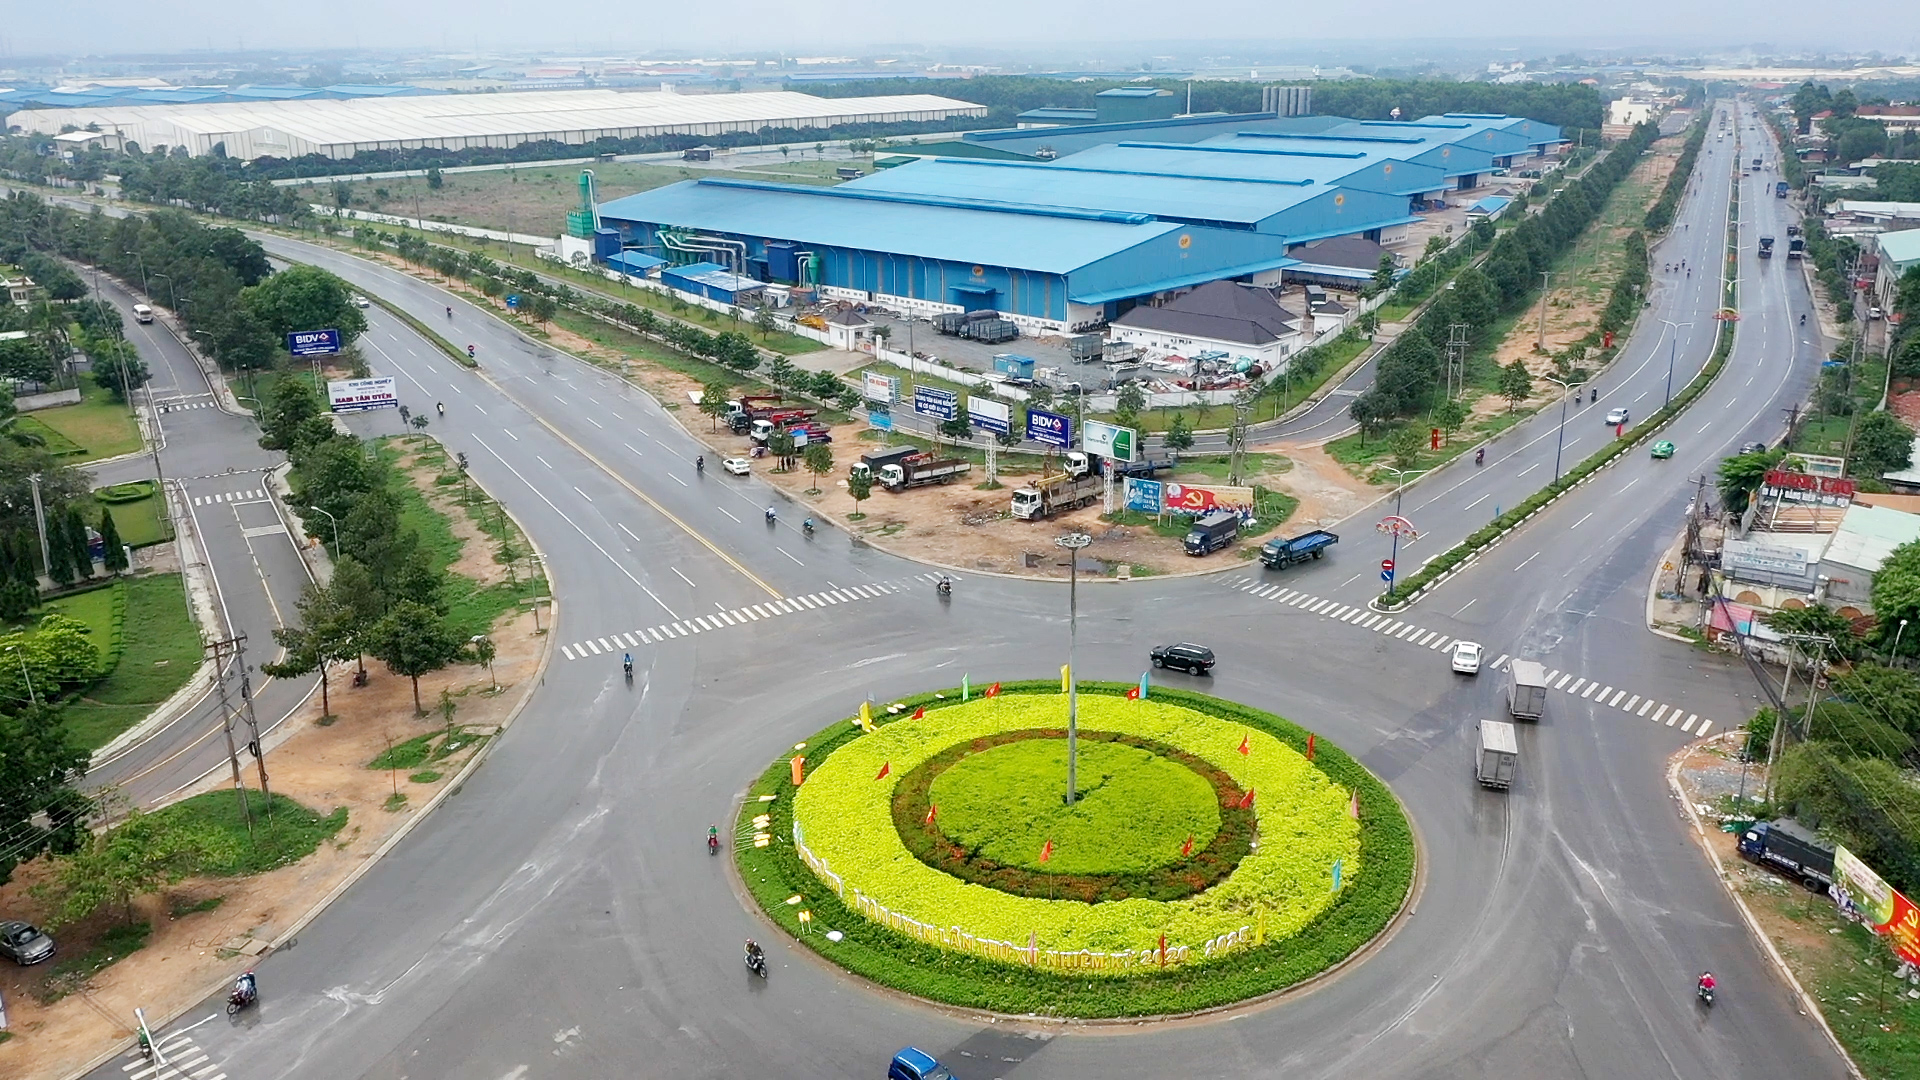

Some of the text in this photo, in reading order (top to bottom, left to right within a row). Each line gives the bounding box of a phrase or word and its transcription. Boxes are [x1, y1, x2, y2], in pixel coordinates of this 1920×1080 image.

[295, 333, 319, 344] BIDV
[1032, 414, 1053, 428] BIDV
[1140, 945, 1190, 966] 2020
